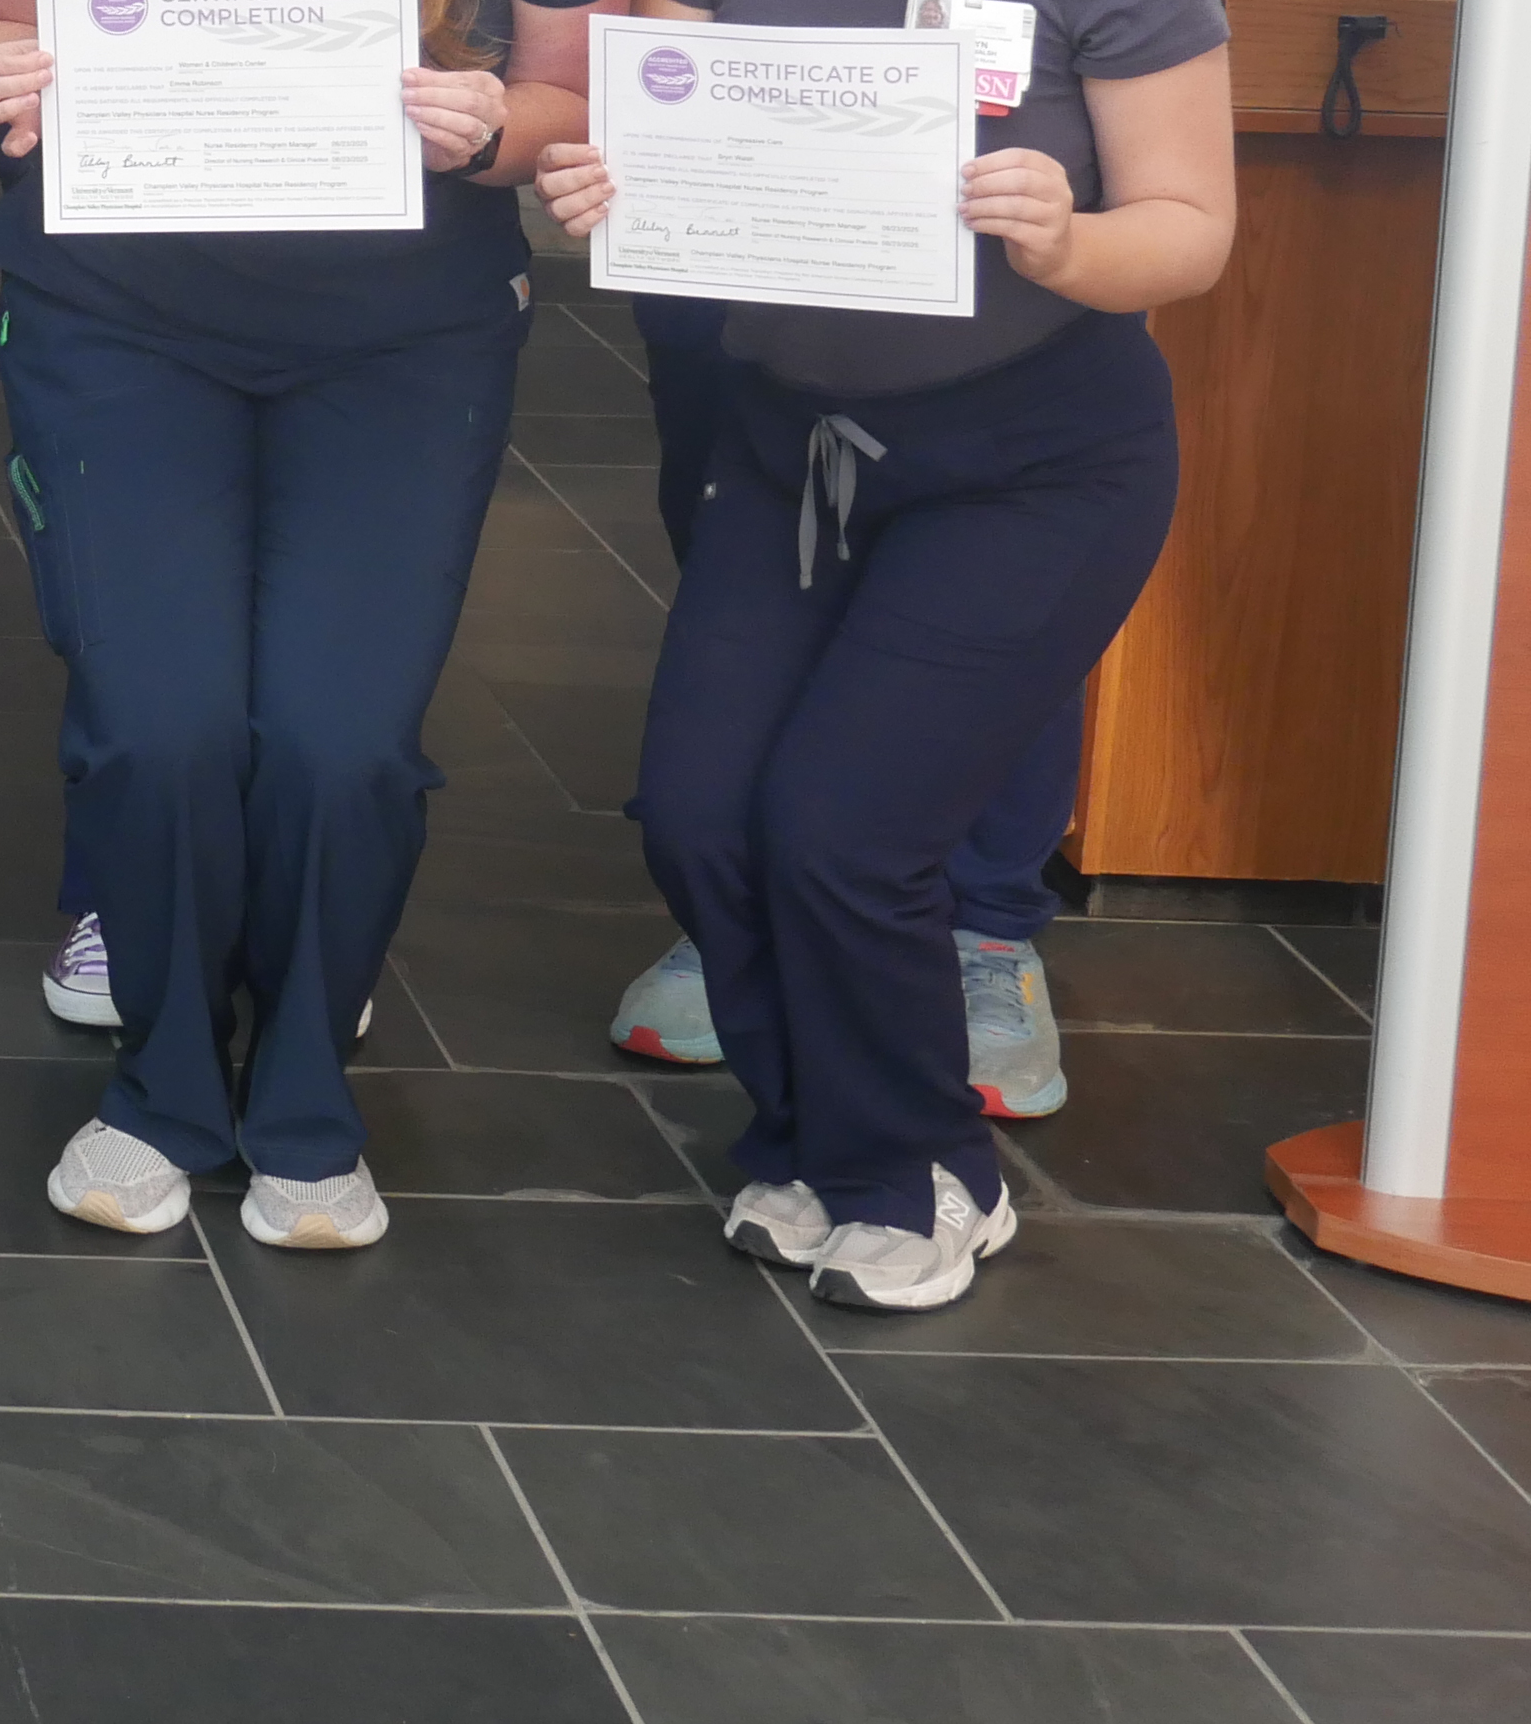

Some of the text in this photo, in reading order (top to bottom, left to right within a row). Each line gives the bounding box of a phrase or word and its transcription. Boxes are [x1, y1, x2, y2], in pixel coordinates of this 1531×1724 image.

[161, 6, 323, 26] COMPLETION
[711, 60, 920, 84] CERTIFICATE OF
[711, 84, 878, 108] COMPLETION
[976, 74, 1013, 97] SN
[728, 137, 765, 145] Progressive
[752, 216, 868, 231] Nurse Residency Program Manager
